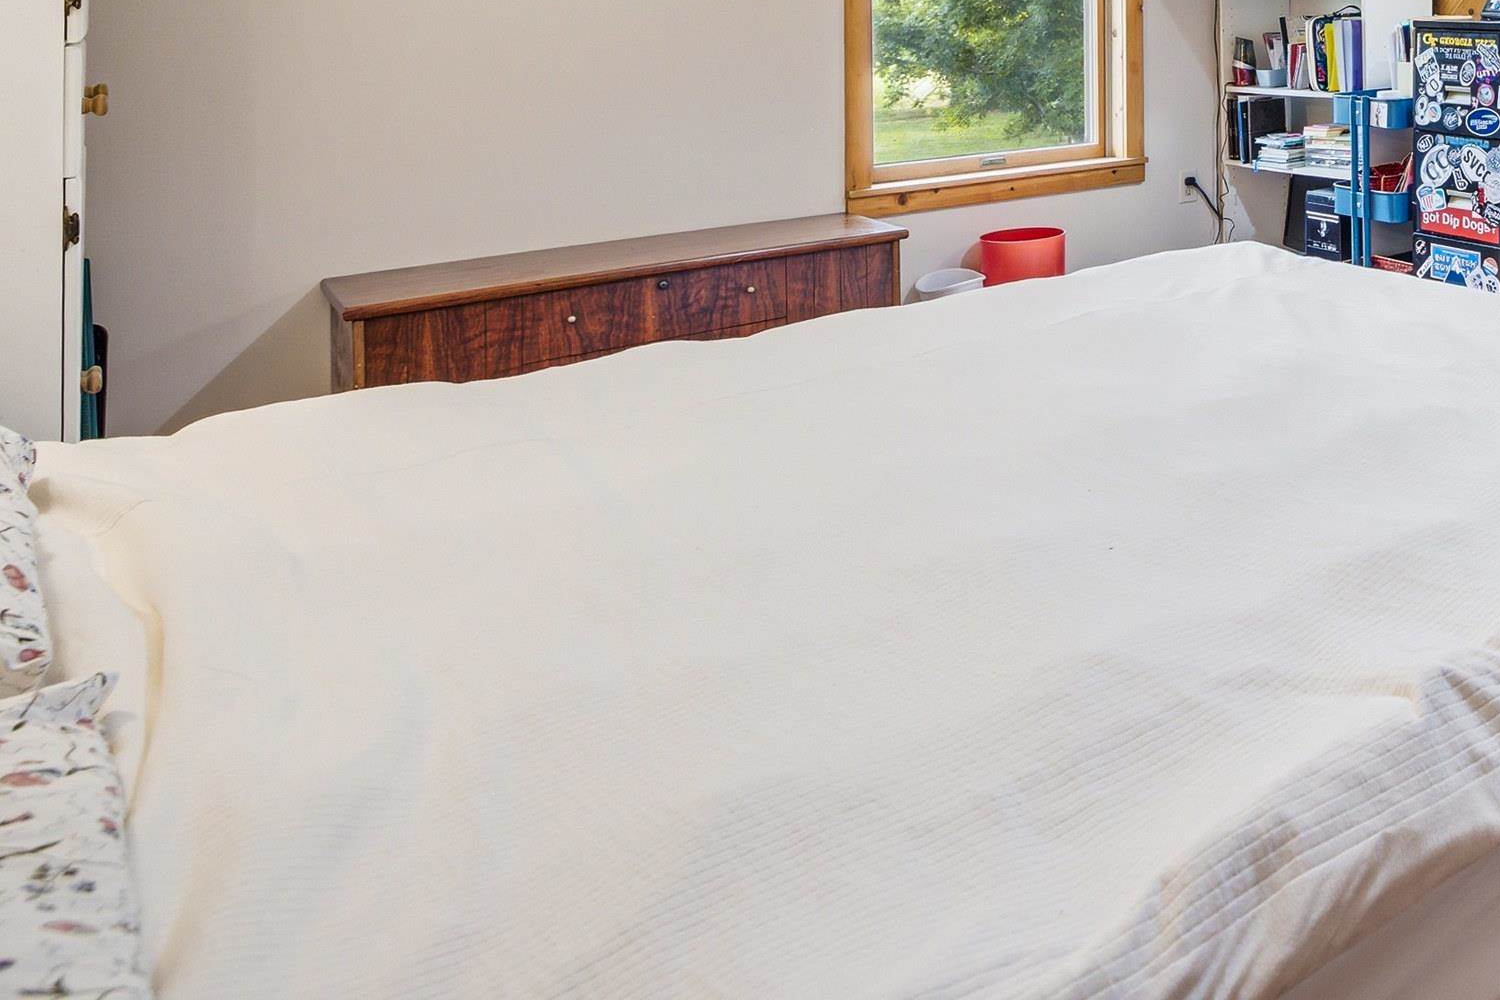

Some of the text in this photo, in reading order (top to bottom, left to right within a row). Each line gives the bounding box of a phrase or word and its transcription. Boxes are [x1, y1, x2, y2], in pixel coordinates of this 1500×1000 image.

[1439, 37, 1473, 47] GEORGIA
[1422, 212, 1440, 224] got
[1442, 213, 1460, 229] Dip
